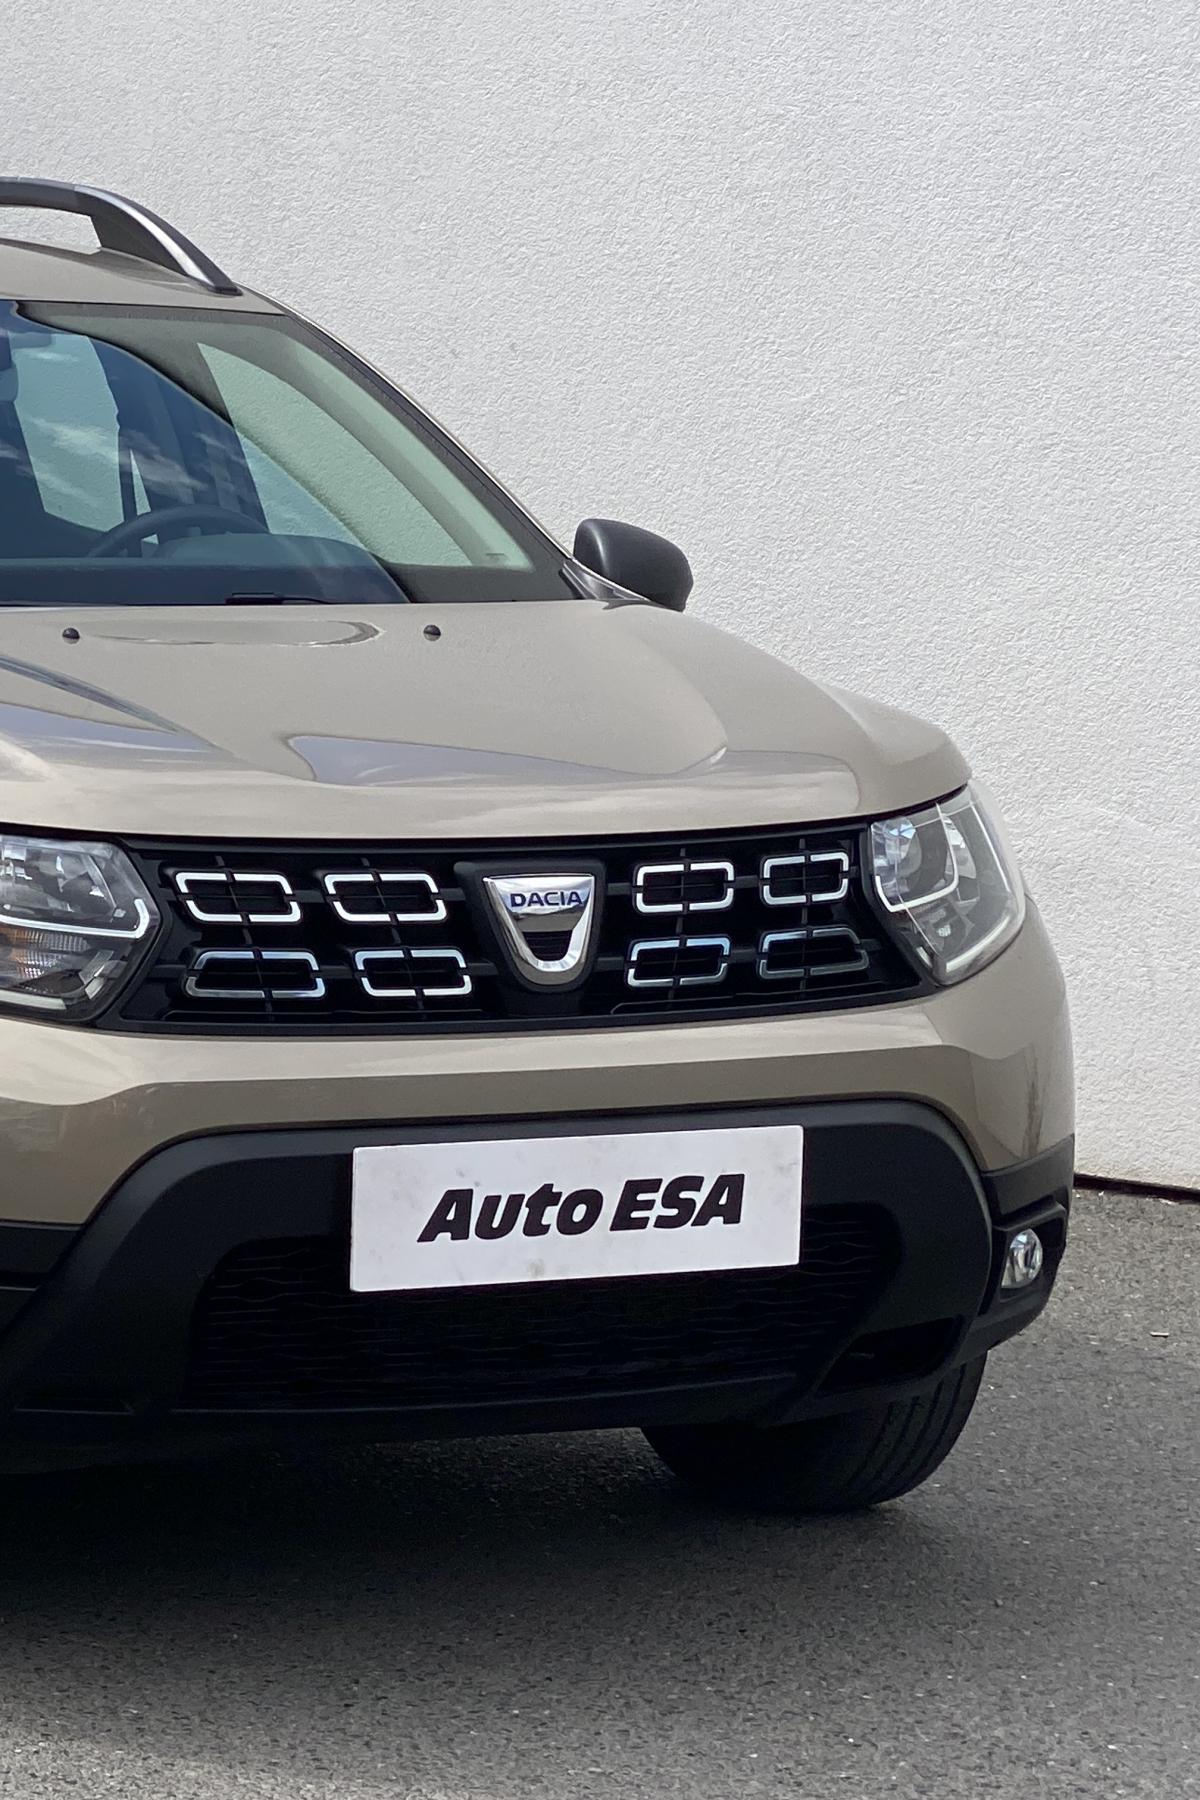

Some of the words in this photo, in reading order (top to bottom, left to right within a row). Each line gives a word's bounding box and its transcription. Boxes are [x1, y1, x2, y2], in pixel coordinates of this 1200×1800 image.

[510, 891, 583, 907] DACIA
[417, 1183, 603, 1243] Auto
[609, 1173, 745, 1232] ESA
